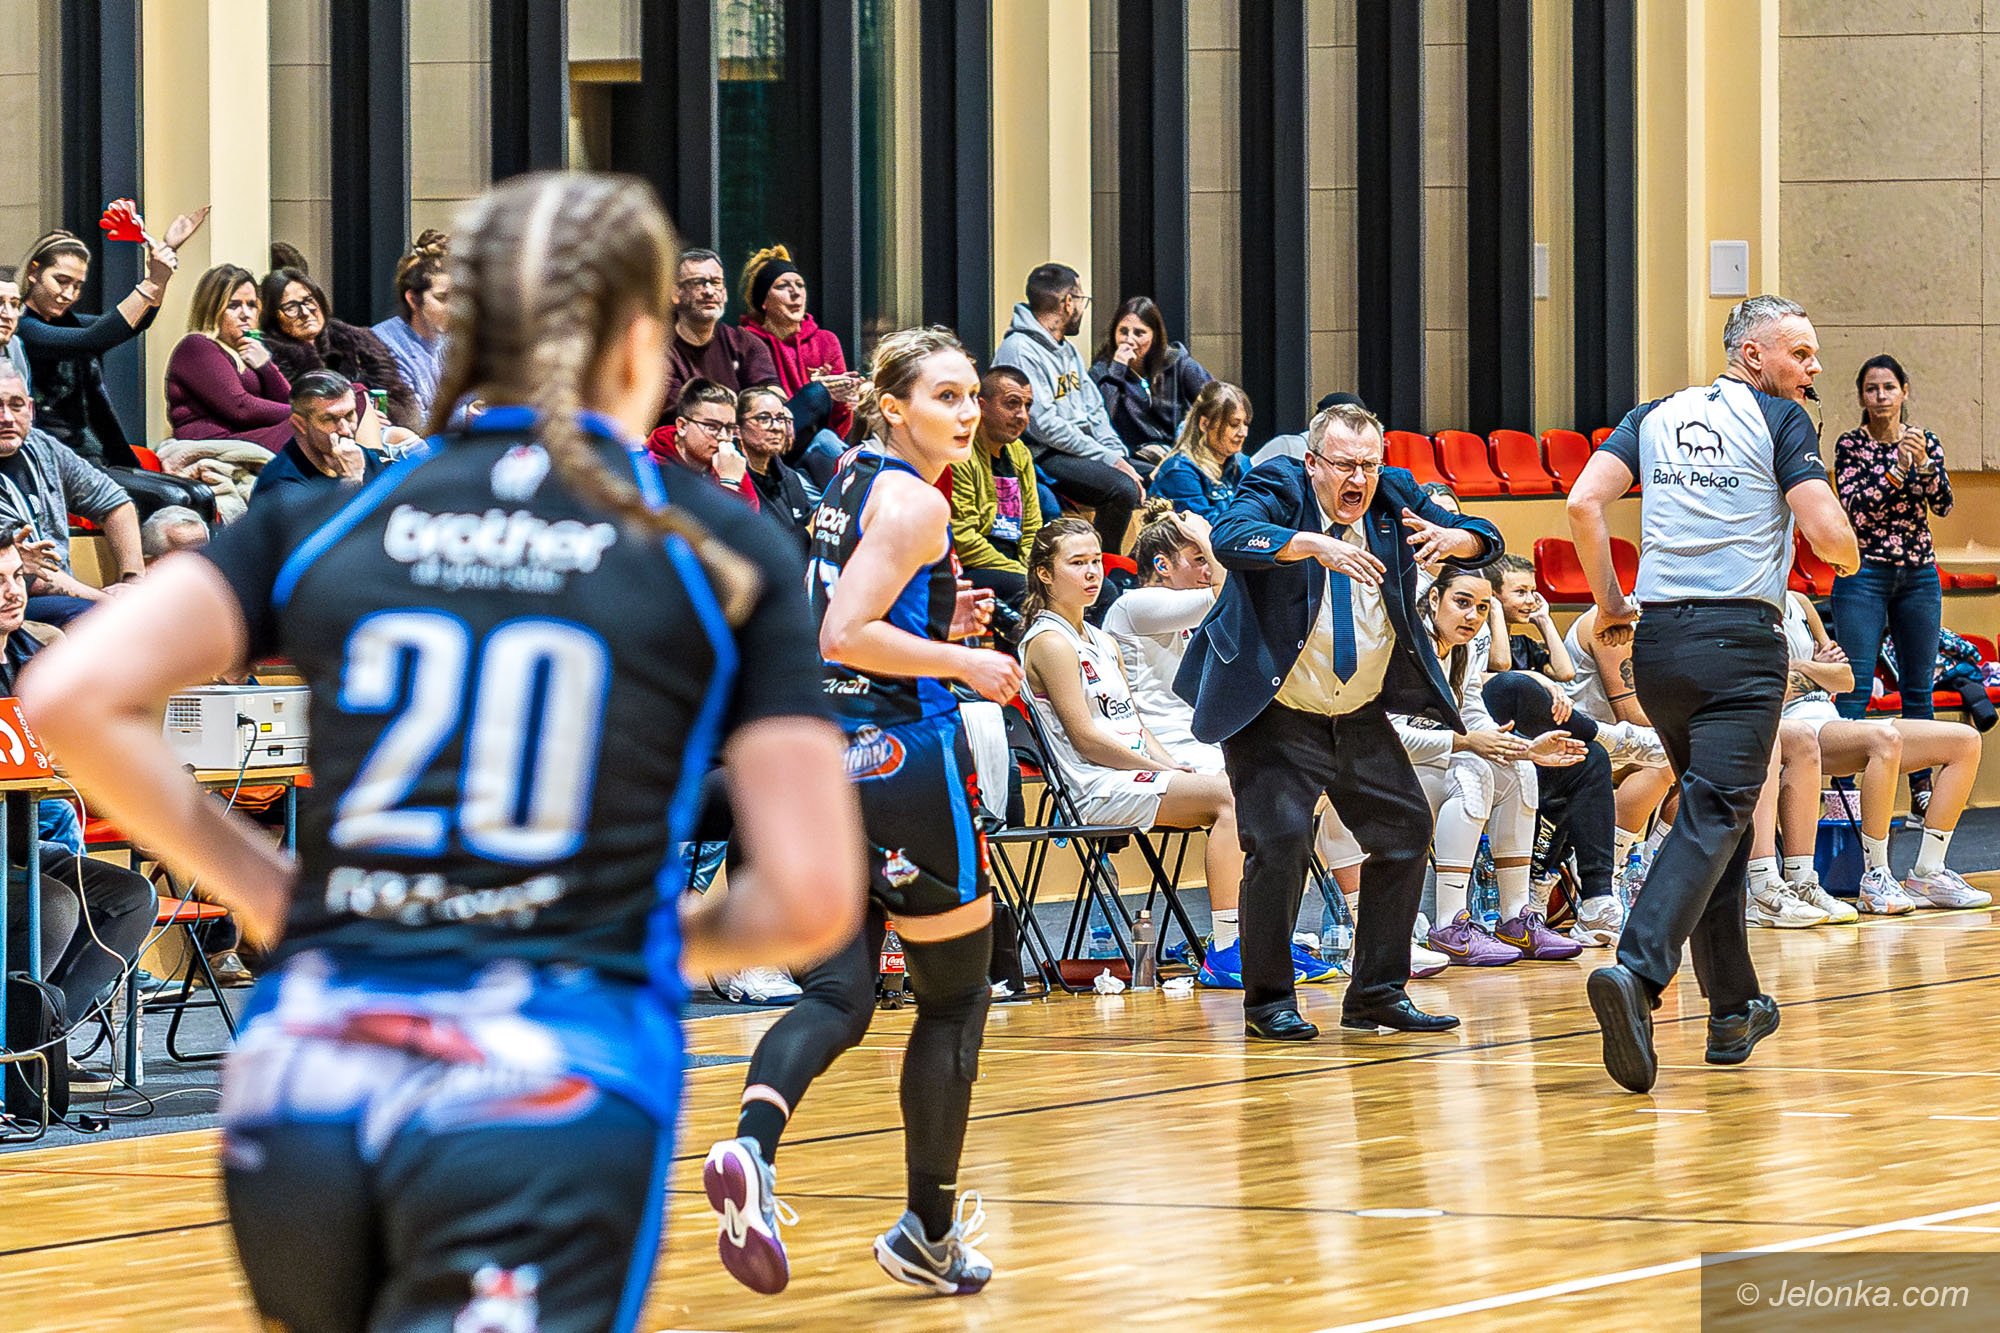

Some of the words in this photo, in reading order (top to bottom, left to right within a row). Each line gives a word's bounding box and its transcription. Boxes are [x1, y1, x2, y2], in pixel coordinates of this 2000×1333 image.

[1652, 468, 1687, 486] Bank
[1690, 471, 1740, 488] Pekao
[383, 503, 618, 574] brother
[328, 606, 614, 866] 20
